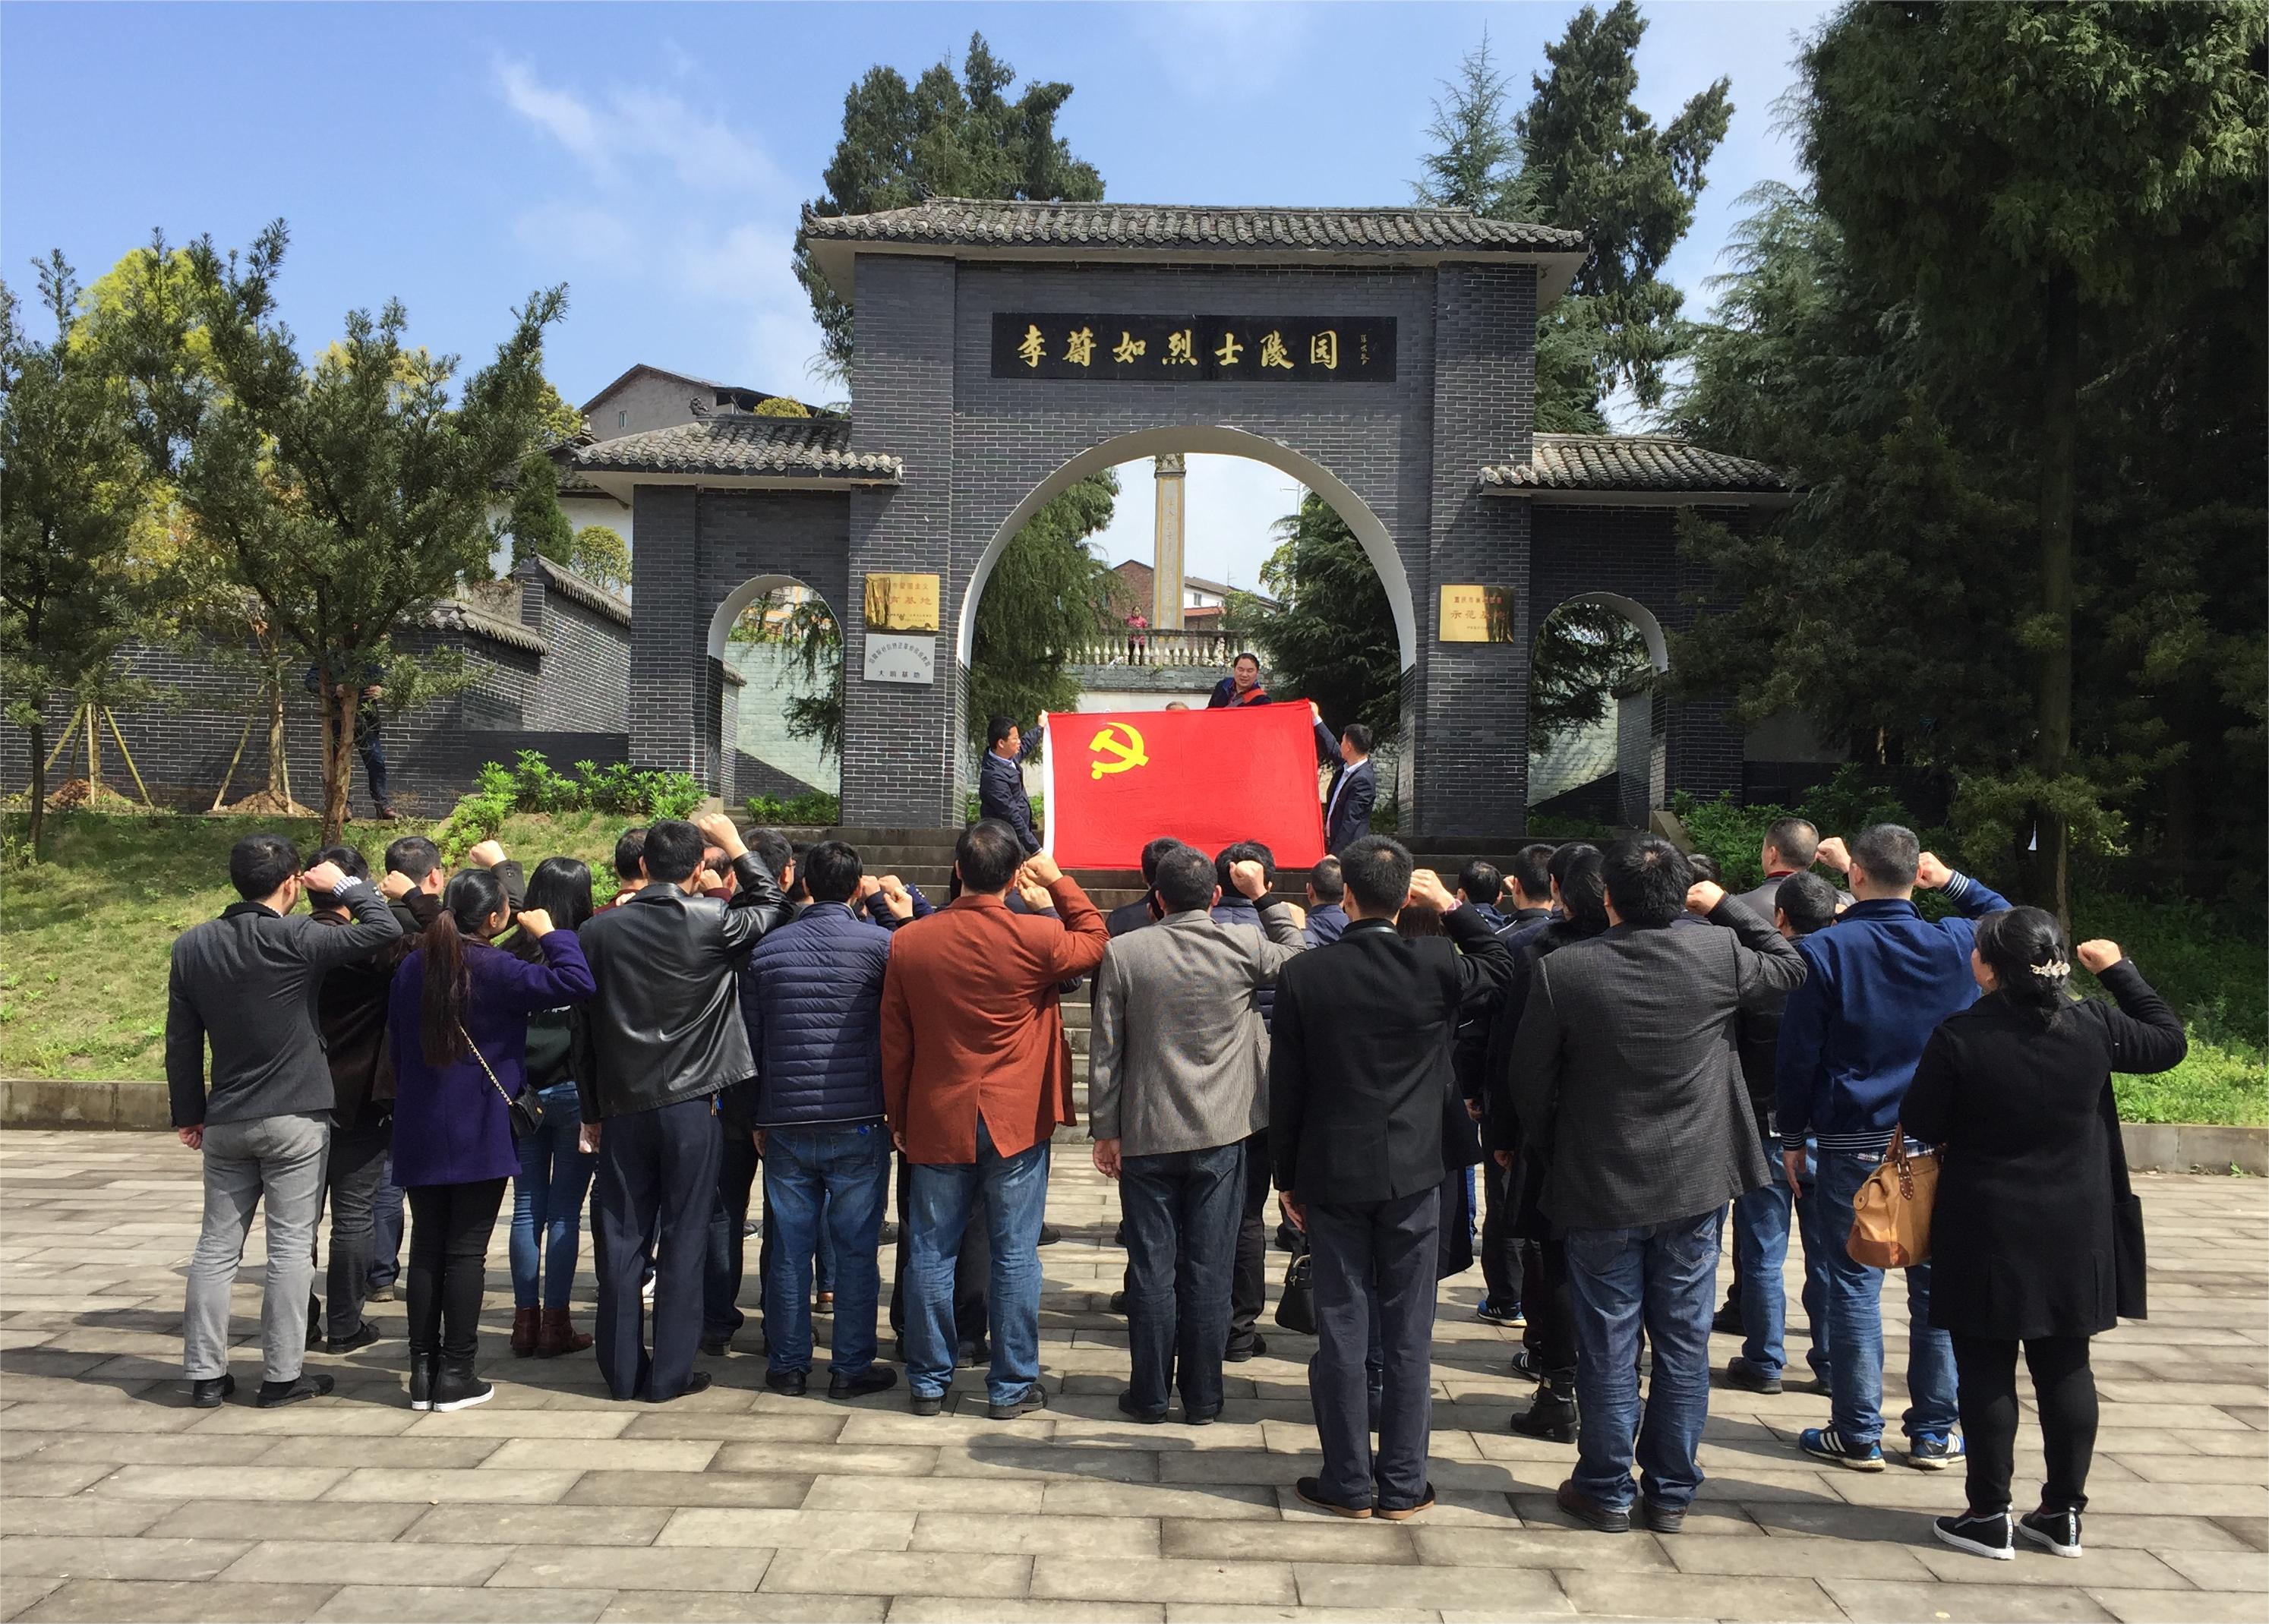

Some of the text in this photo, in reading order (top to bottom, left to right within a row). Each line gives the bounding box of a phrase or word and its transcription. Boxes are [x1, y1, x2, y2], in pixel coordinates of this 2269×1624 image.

[1017, 324, 1338, 370] 李蔚如烈士陵园
